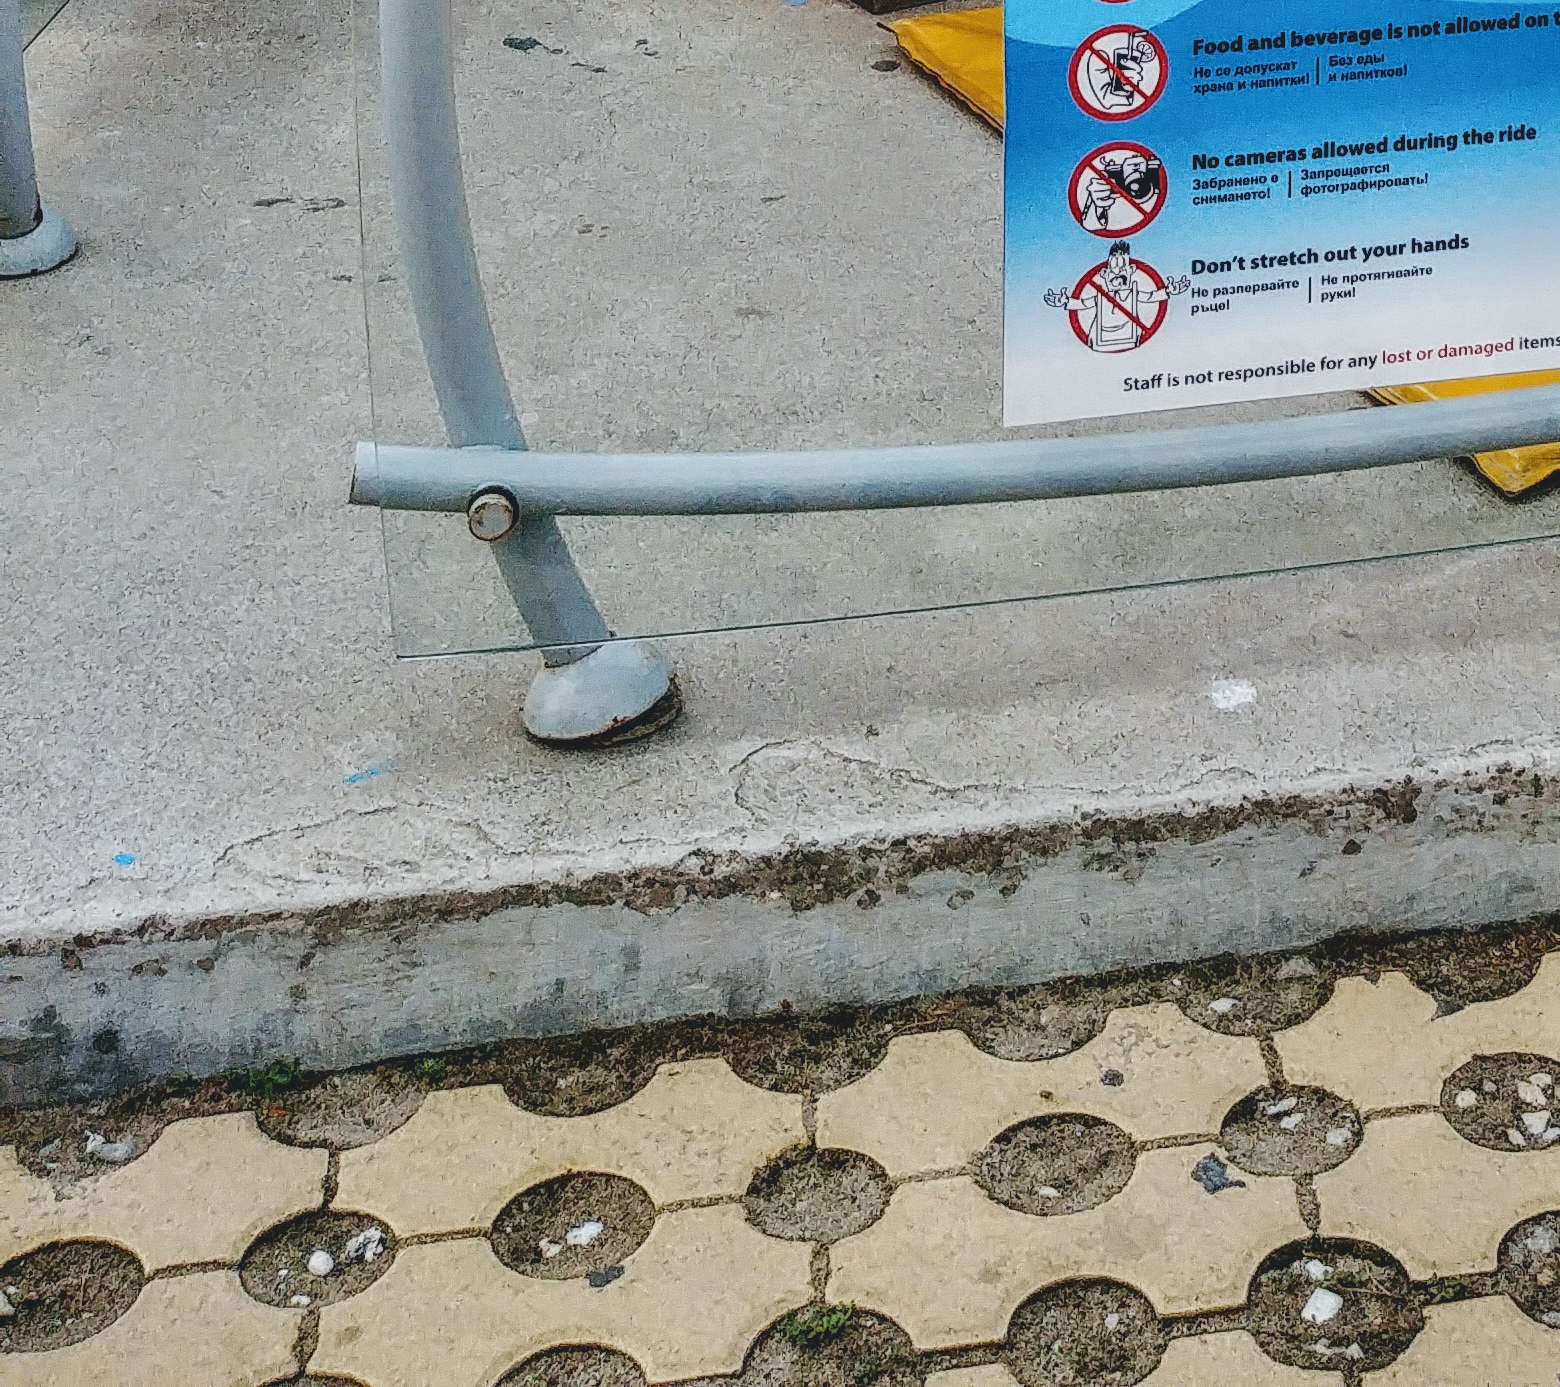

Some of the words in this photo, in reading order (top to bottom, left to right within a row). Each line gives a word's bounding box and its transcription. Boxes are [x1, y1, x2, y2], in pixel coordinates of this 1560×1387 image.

[1193, 35, 1243, 56] Food
[1248, 32, 1286, 51] and
[1291, 27, 1383, 48] beverage
[1387, 22, 1403, 39] is
[1407, 20, 1440, 38] not
[1445, 12, 1520, 35] allowed
[1524, 14, 1549, 28] on
[1234, 60, 1298, 76] допускат
[1329, 55, 1352, 67] Без
[1329, 72, 1337, 81] и
[1341, 64, 1408, 81] напитков!
[1193, 82, 1234, 96] храна
[1238, 80, 1246, 90] и
[1250, 72, 1310, 89] напитки!
[1192, 154, 1219, 170] No
[1224, 147, 1307, 167] cameras
[1312, 136, 1388, 160] allowed
[1393, 133, 1458, 151] during
[1462, 128, 1494, 145] the
[1499, 124, 1536, 142] ride
[1193, 175, 1267, 191] Забранено
[1301, 173, 1429, 197] фотографировать!
[1193, 188, 1271, 205] снимането!
[1250, 248, 1318, 270] stretch
[1323, 245, 1357, 262] out
[1362, 242, 1406, 263] your
[1411, 234, 1470, 254] hands
[1342, 265, 1433, 284] протягивайте
[1321, 287, 1356, 302] руки!
[1123, 374, 1164, 392] Staff
[1167, 373, 1179, 387] is
[1184, 370, 1213, 385] not
[1218, 359, 1316, 384] responsible
[1320, 356, 1344, 371] for
[1348, 353, 1378, 372] any
[1382, 349, 1412, 365] lost
[1416, 348, 1434, 362] or
[1437, 337, 1515, 359] damaged
